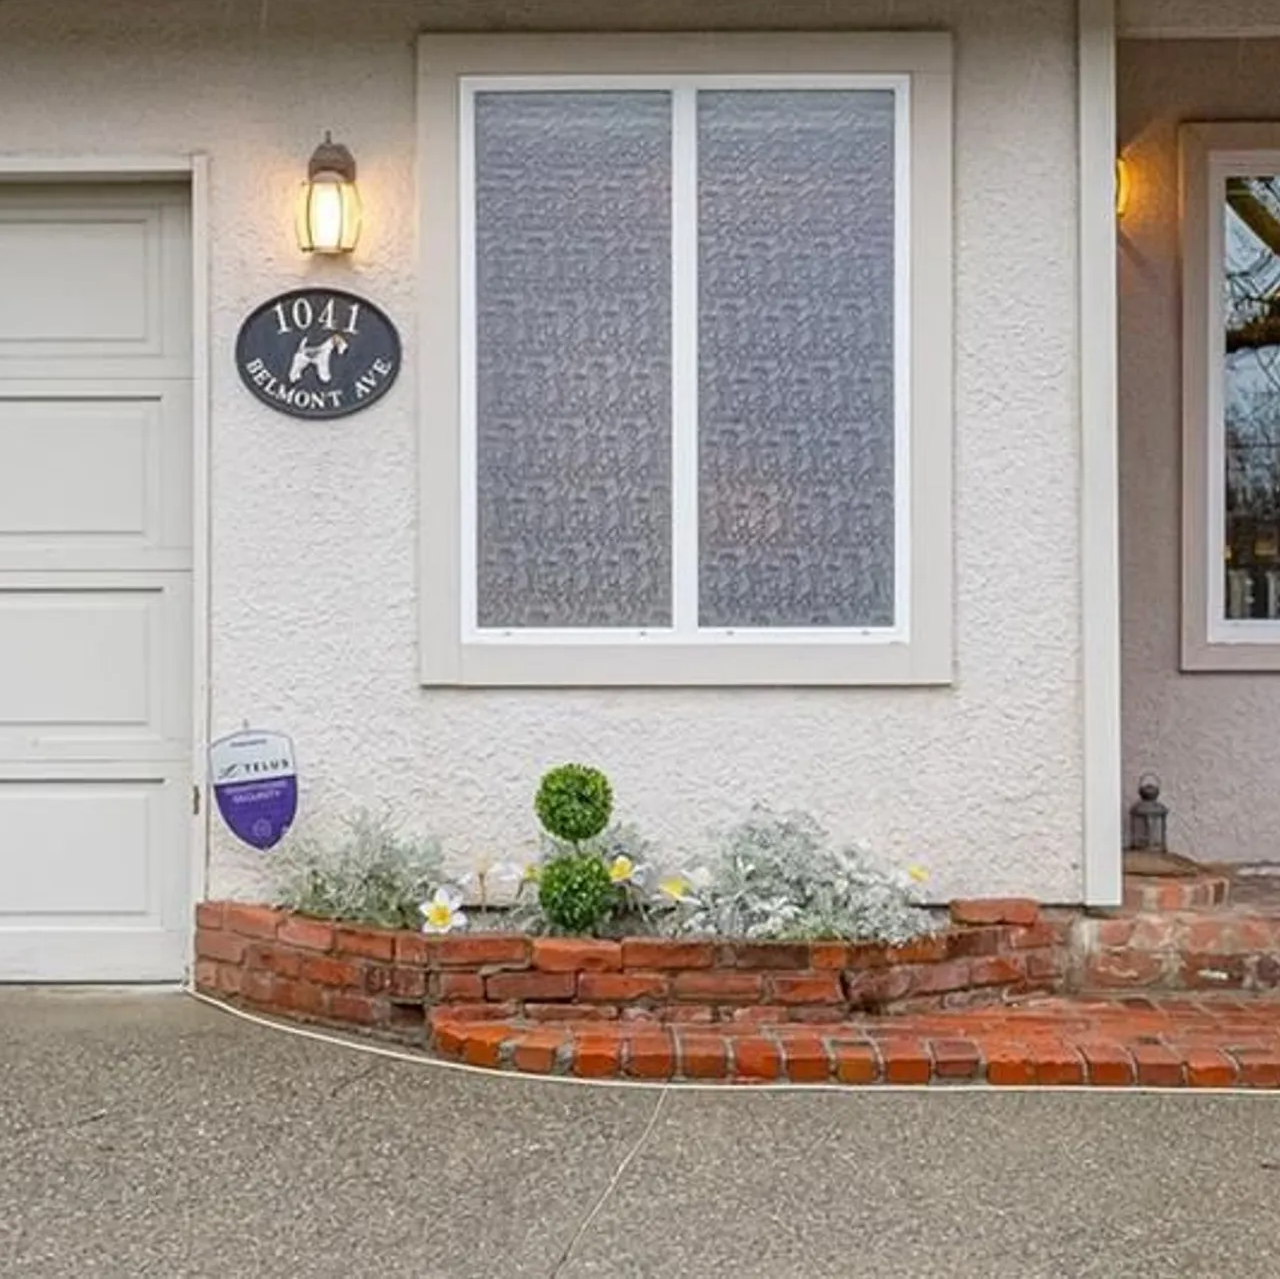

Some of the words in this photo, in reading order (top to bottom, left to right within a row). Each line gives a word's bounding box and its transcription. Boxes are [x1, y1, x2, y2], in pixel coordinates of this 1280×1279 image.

[272, 297, 361, 335] 1041
[245, 357, 343, 409] BELMONT
[353, 358, 393, 399] AVE
[243, 758, 289, 774] TELUS
